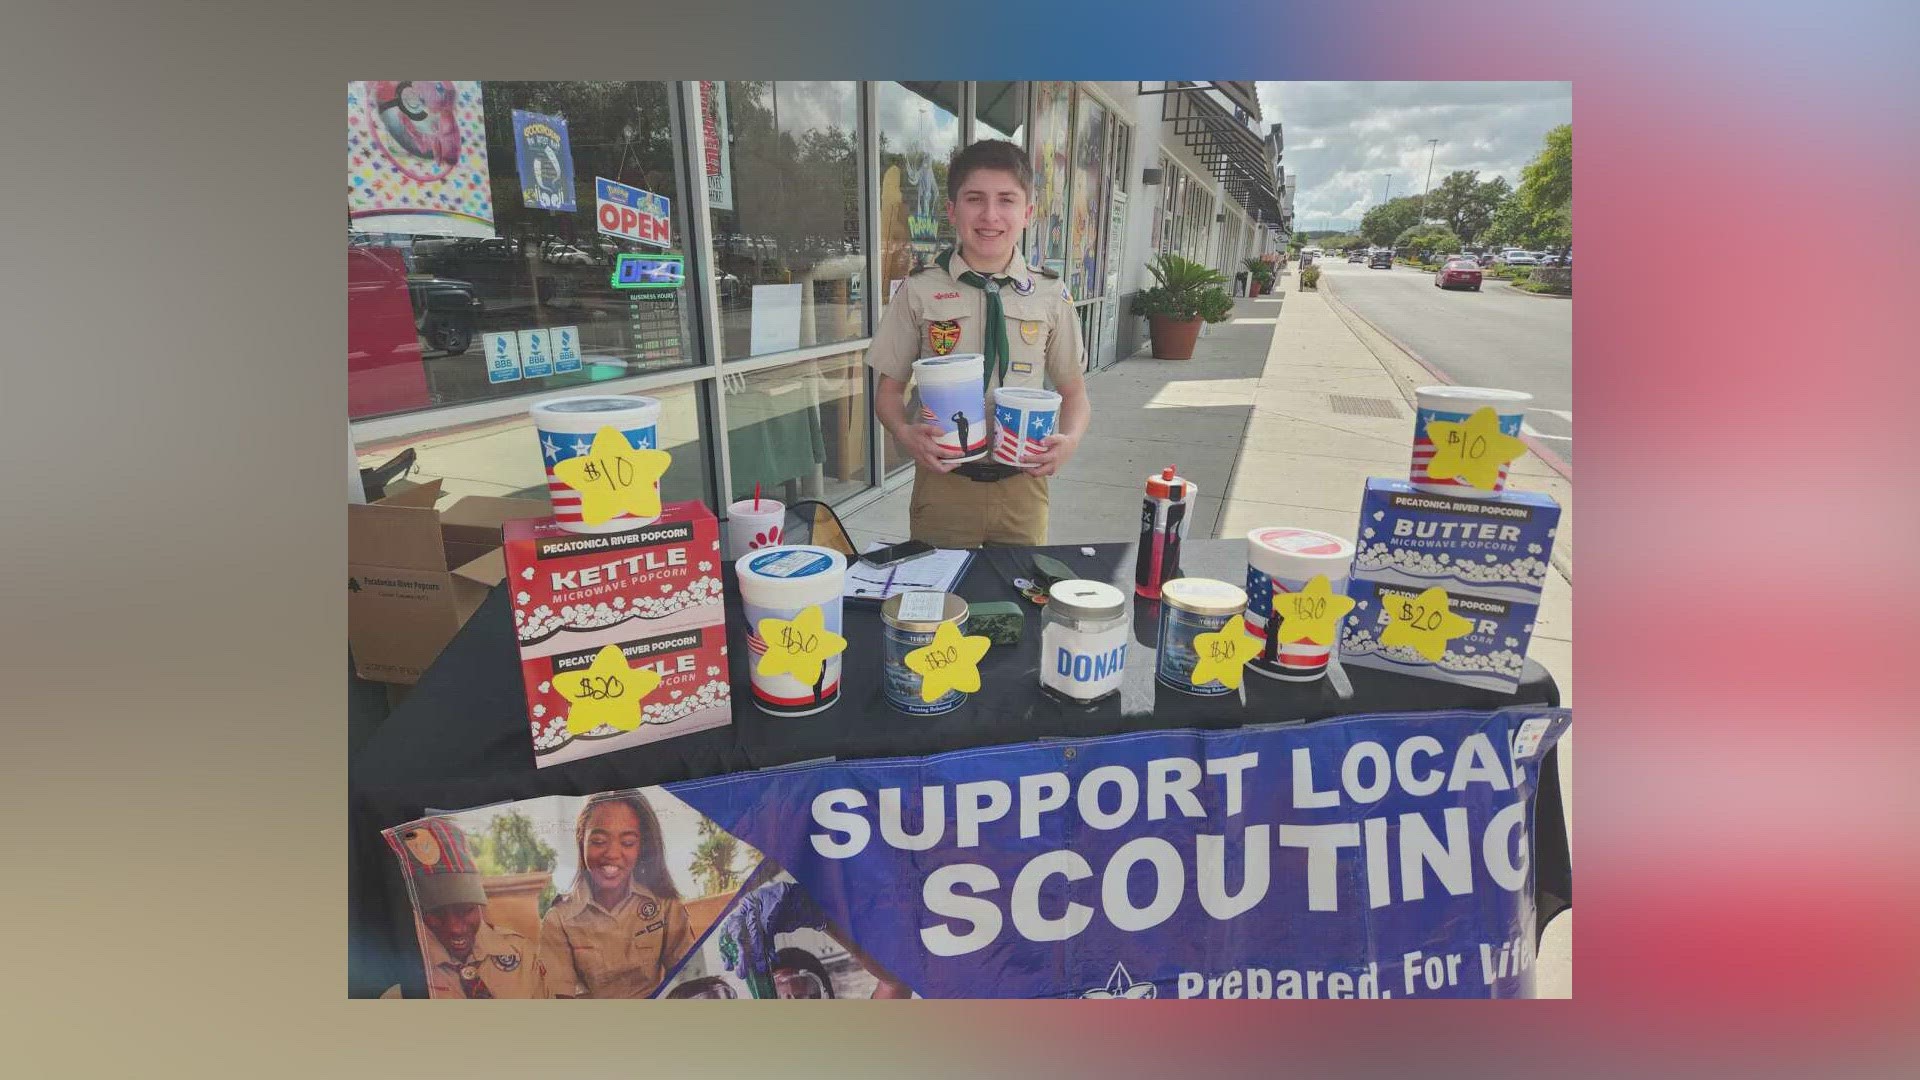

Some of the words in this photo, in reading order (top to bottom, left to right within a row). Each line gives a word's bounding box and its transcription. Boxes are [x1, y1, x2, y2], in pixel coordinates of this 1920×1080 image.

[600, 203, 669, 241] OPEN
[495, 360, 513, 369] BBB
[529, 355, 545, 364] BBB
[1448, 431, 1486, 459] $10
[583, 457, 634, 491] $10
[1395, 496, 1450, 510] PECATONICA
[1452, 502, 1479, 513] RIVER
[1481, 506, 1528, 518] POPCORN
[543, 538, 609, 554] PECATONICA
[611, 534, 640, 546] RIVER
[641, 528, 688, 542] POPCORN
[1393, 518, 1521, 542] BUTTER
[1390, 538, 1456, 548] MICROWAVE
[1460, 541, 1517, 552] POPCORN
[551, 548, 688, 591] KETTLE
[552, 579, 628, 604] MICROWAVE
[632, 568, 688, 585] POPCORN
[1293, 596, 1327, 620] $20
[1379, 588, 1419, 600] PECATON
[1460, 600, 1505, 613] POPCORN
[1399, 601, 1443, 631] $20
[559, 653, 597, 668] PECATO
[623, 643, 650, 656] RIVER
[651, 635, 697, 651] POPCORN
[775, 626, 819, 655] $20
[1210, 640, 1236, 663] $20
[1464, 634, 1494, 645] CORN
[925, 645, 958, 671] $20
[1057, 643, 1127, 682] DONAT
[575, 675, 625, 700] $20
[659, 674, 696, 688] PCORN
[908, 705, 929, 713] Evening
[810, 751, 1259, 859] SUPPORT
[920, 800, 1530, 957] SCOUTING
[1178, 962, 1391, 1000] Prepared.
[1403, 950, 1462, 996] For
